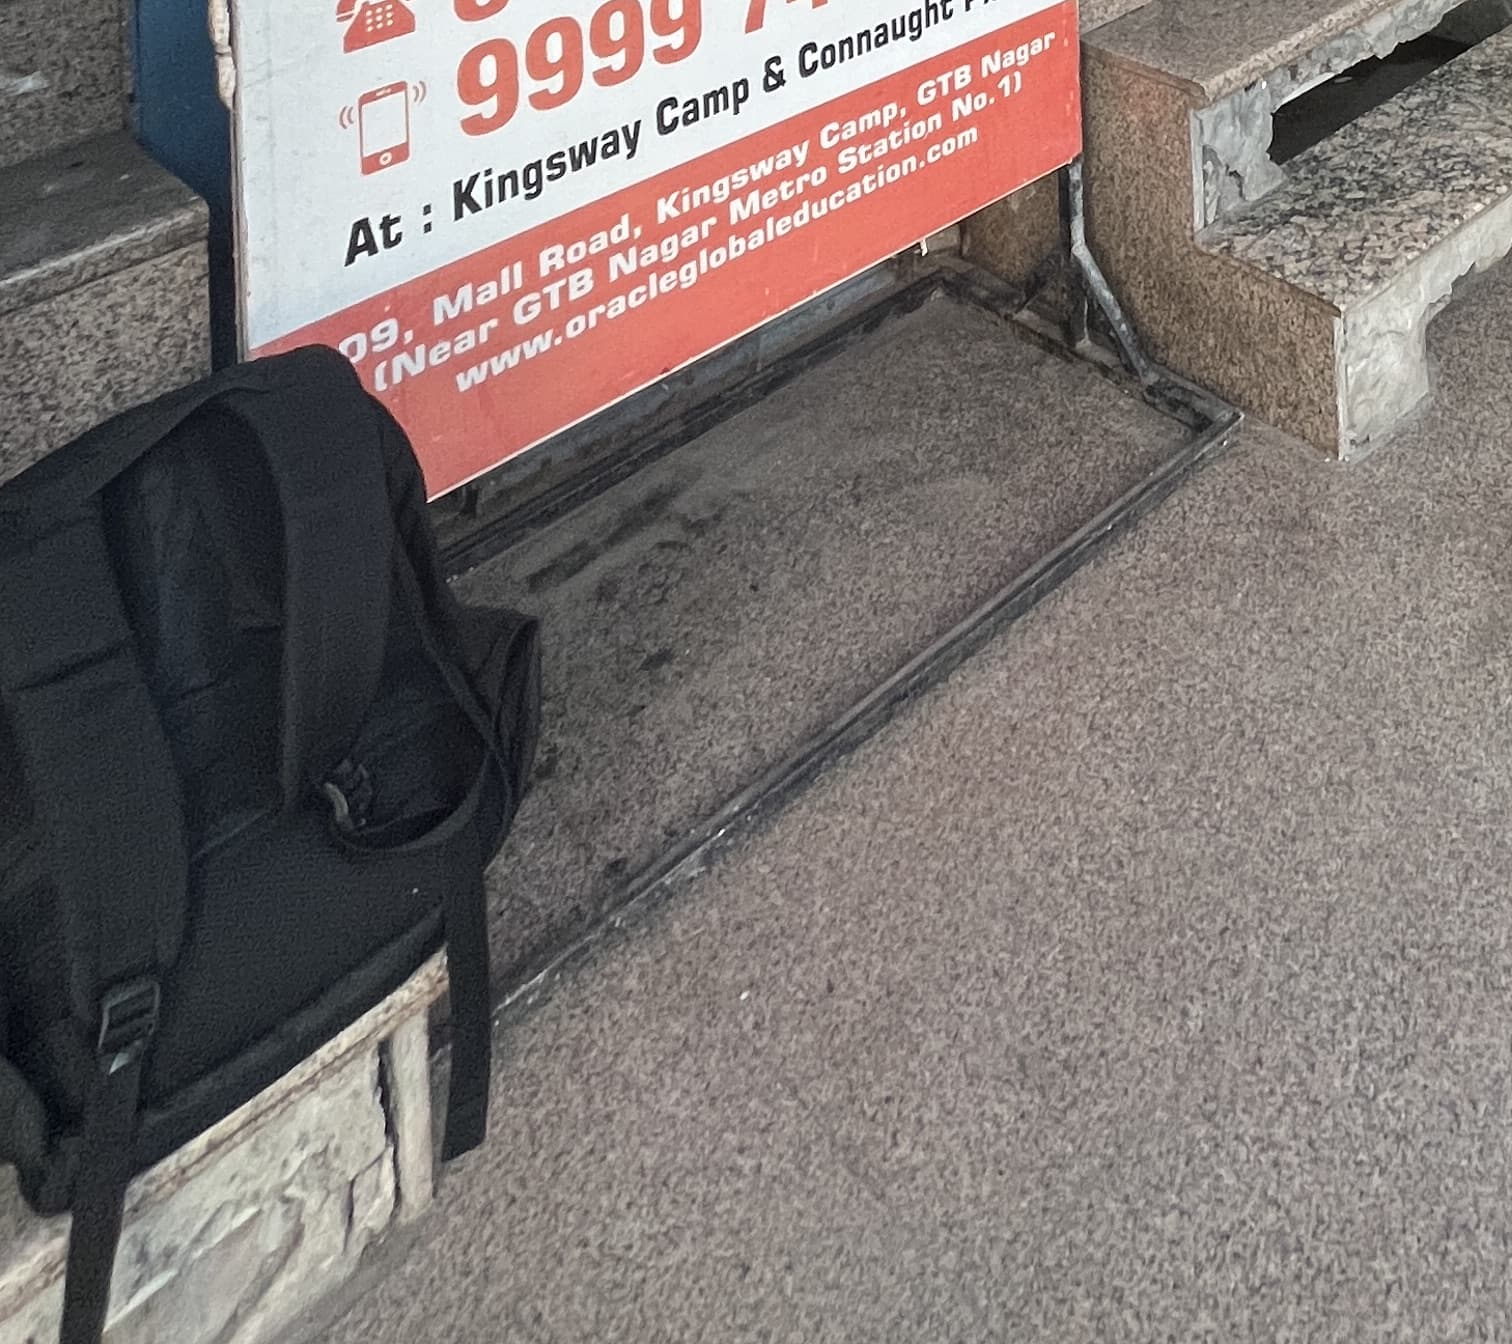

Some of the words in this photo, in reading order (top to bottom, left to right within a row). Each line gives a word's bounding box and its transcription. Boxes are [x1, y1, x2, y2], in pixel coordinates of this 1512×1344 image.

[339, 313, 414, 365] 09,
[432, 262, 523, 317] Mall
[538, 217, 642, 279] Road,
[654, 139, 809, 225] Kingsway
[819, 106, 908, 156] Camp,
[917, 65, 975, 106] GTB
[981, 29, 1056, 81] Nagar
[343, 212, 403, 267] At
[453, 118, 642, 224] Kingsway
[656, 78, 750, 148] Camp
[762, 55, 786, 91] &
[372, 317, 500, 393] (Near
[512, 273, 595, 331] GTB
[606, 219, 718, 289] Nagar
[728, 167, 828, 228] Metro
[838, 113, 943, 184] Station
[951, 74, 1022, 129] No.1)
[454, 124, 979, 393] www.oracleglobaleducation.com
